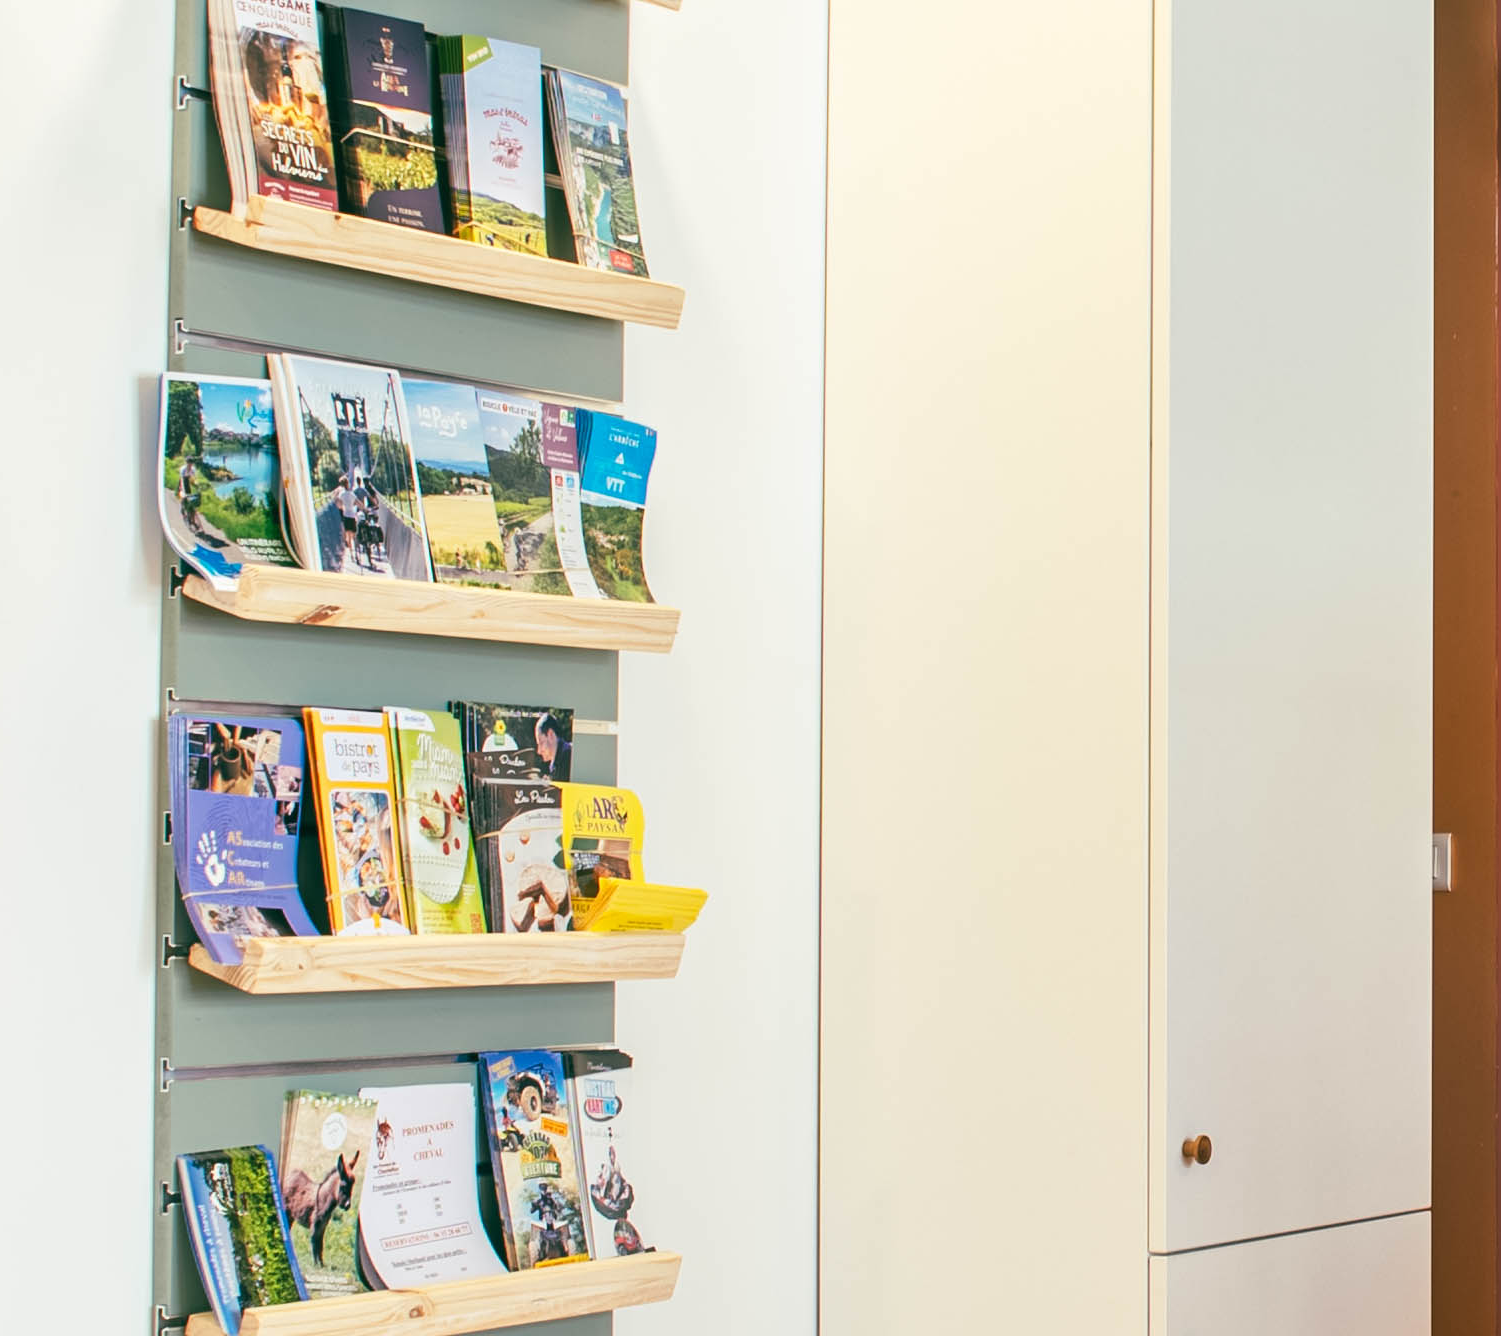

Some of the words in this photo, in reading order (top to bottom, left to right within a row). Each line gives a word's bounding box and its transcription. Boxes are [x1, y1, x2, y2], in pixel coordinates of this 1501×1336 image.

[260, 120, 315, 147] SECRETS
[278, 142, 290, 154] DU
[289, 143, 317, 171] VIN
[605, 476, 626, 494] VTT
[334, 739, 379, 759] bistrot
[351, 760, 381, 781] pays
[585, 821, 626, 834] PAYSAN
[402, 1120, 455, 1137] PROMENADES
[413, 1149, 444, 1162] CHEVAL
